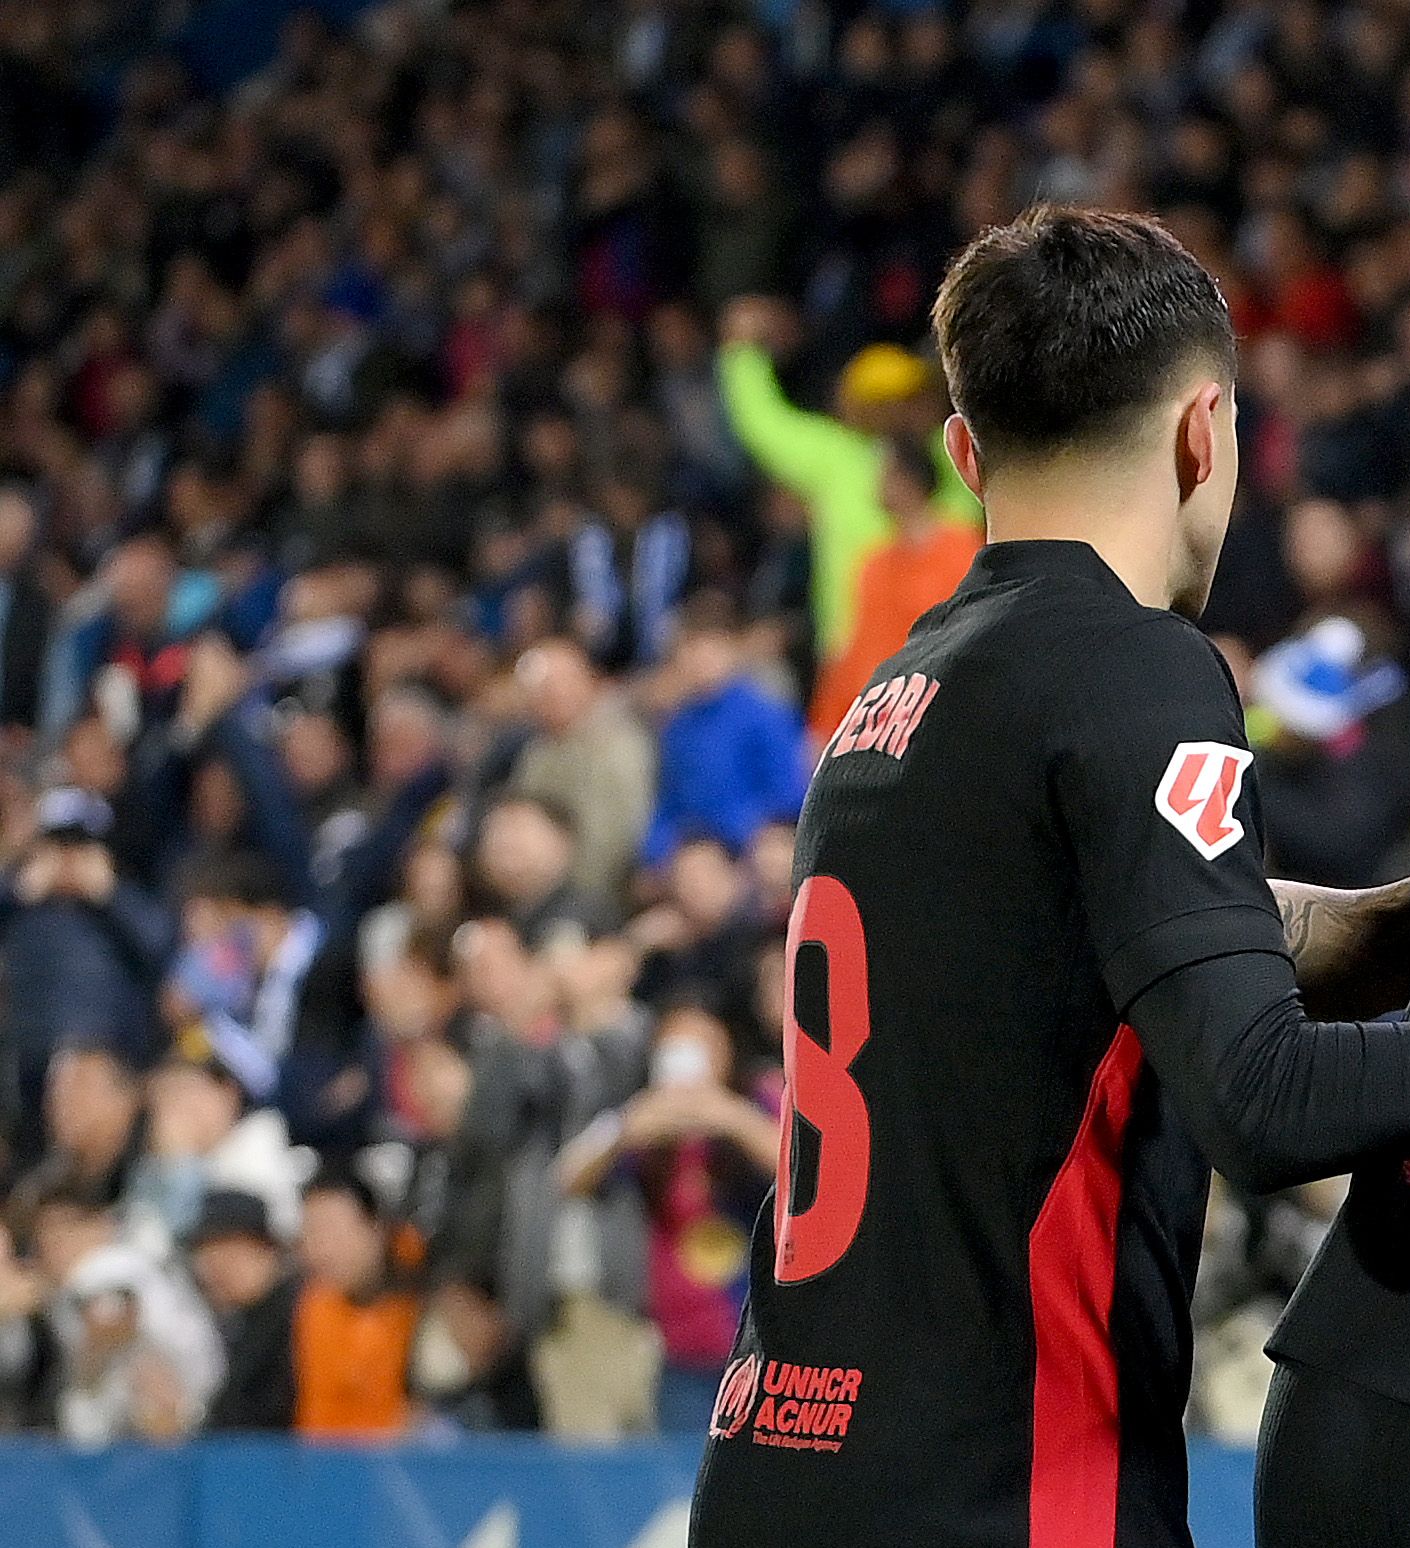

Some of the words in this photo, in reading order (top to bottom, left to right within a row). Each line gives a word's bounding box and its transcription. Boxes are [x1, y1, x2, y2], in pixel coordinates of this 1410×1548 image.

[774, 874, 871, 1285] 8
[762, 1360, 863, 1402] UNHCR
[753, 1396, 852, 1437] ACNUR
